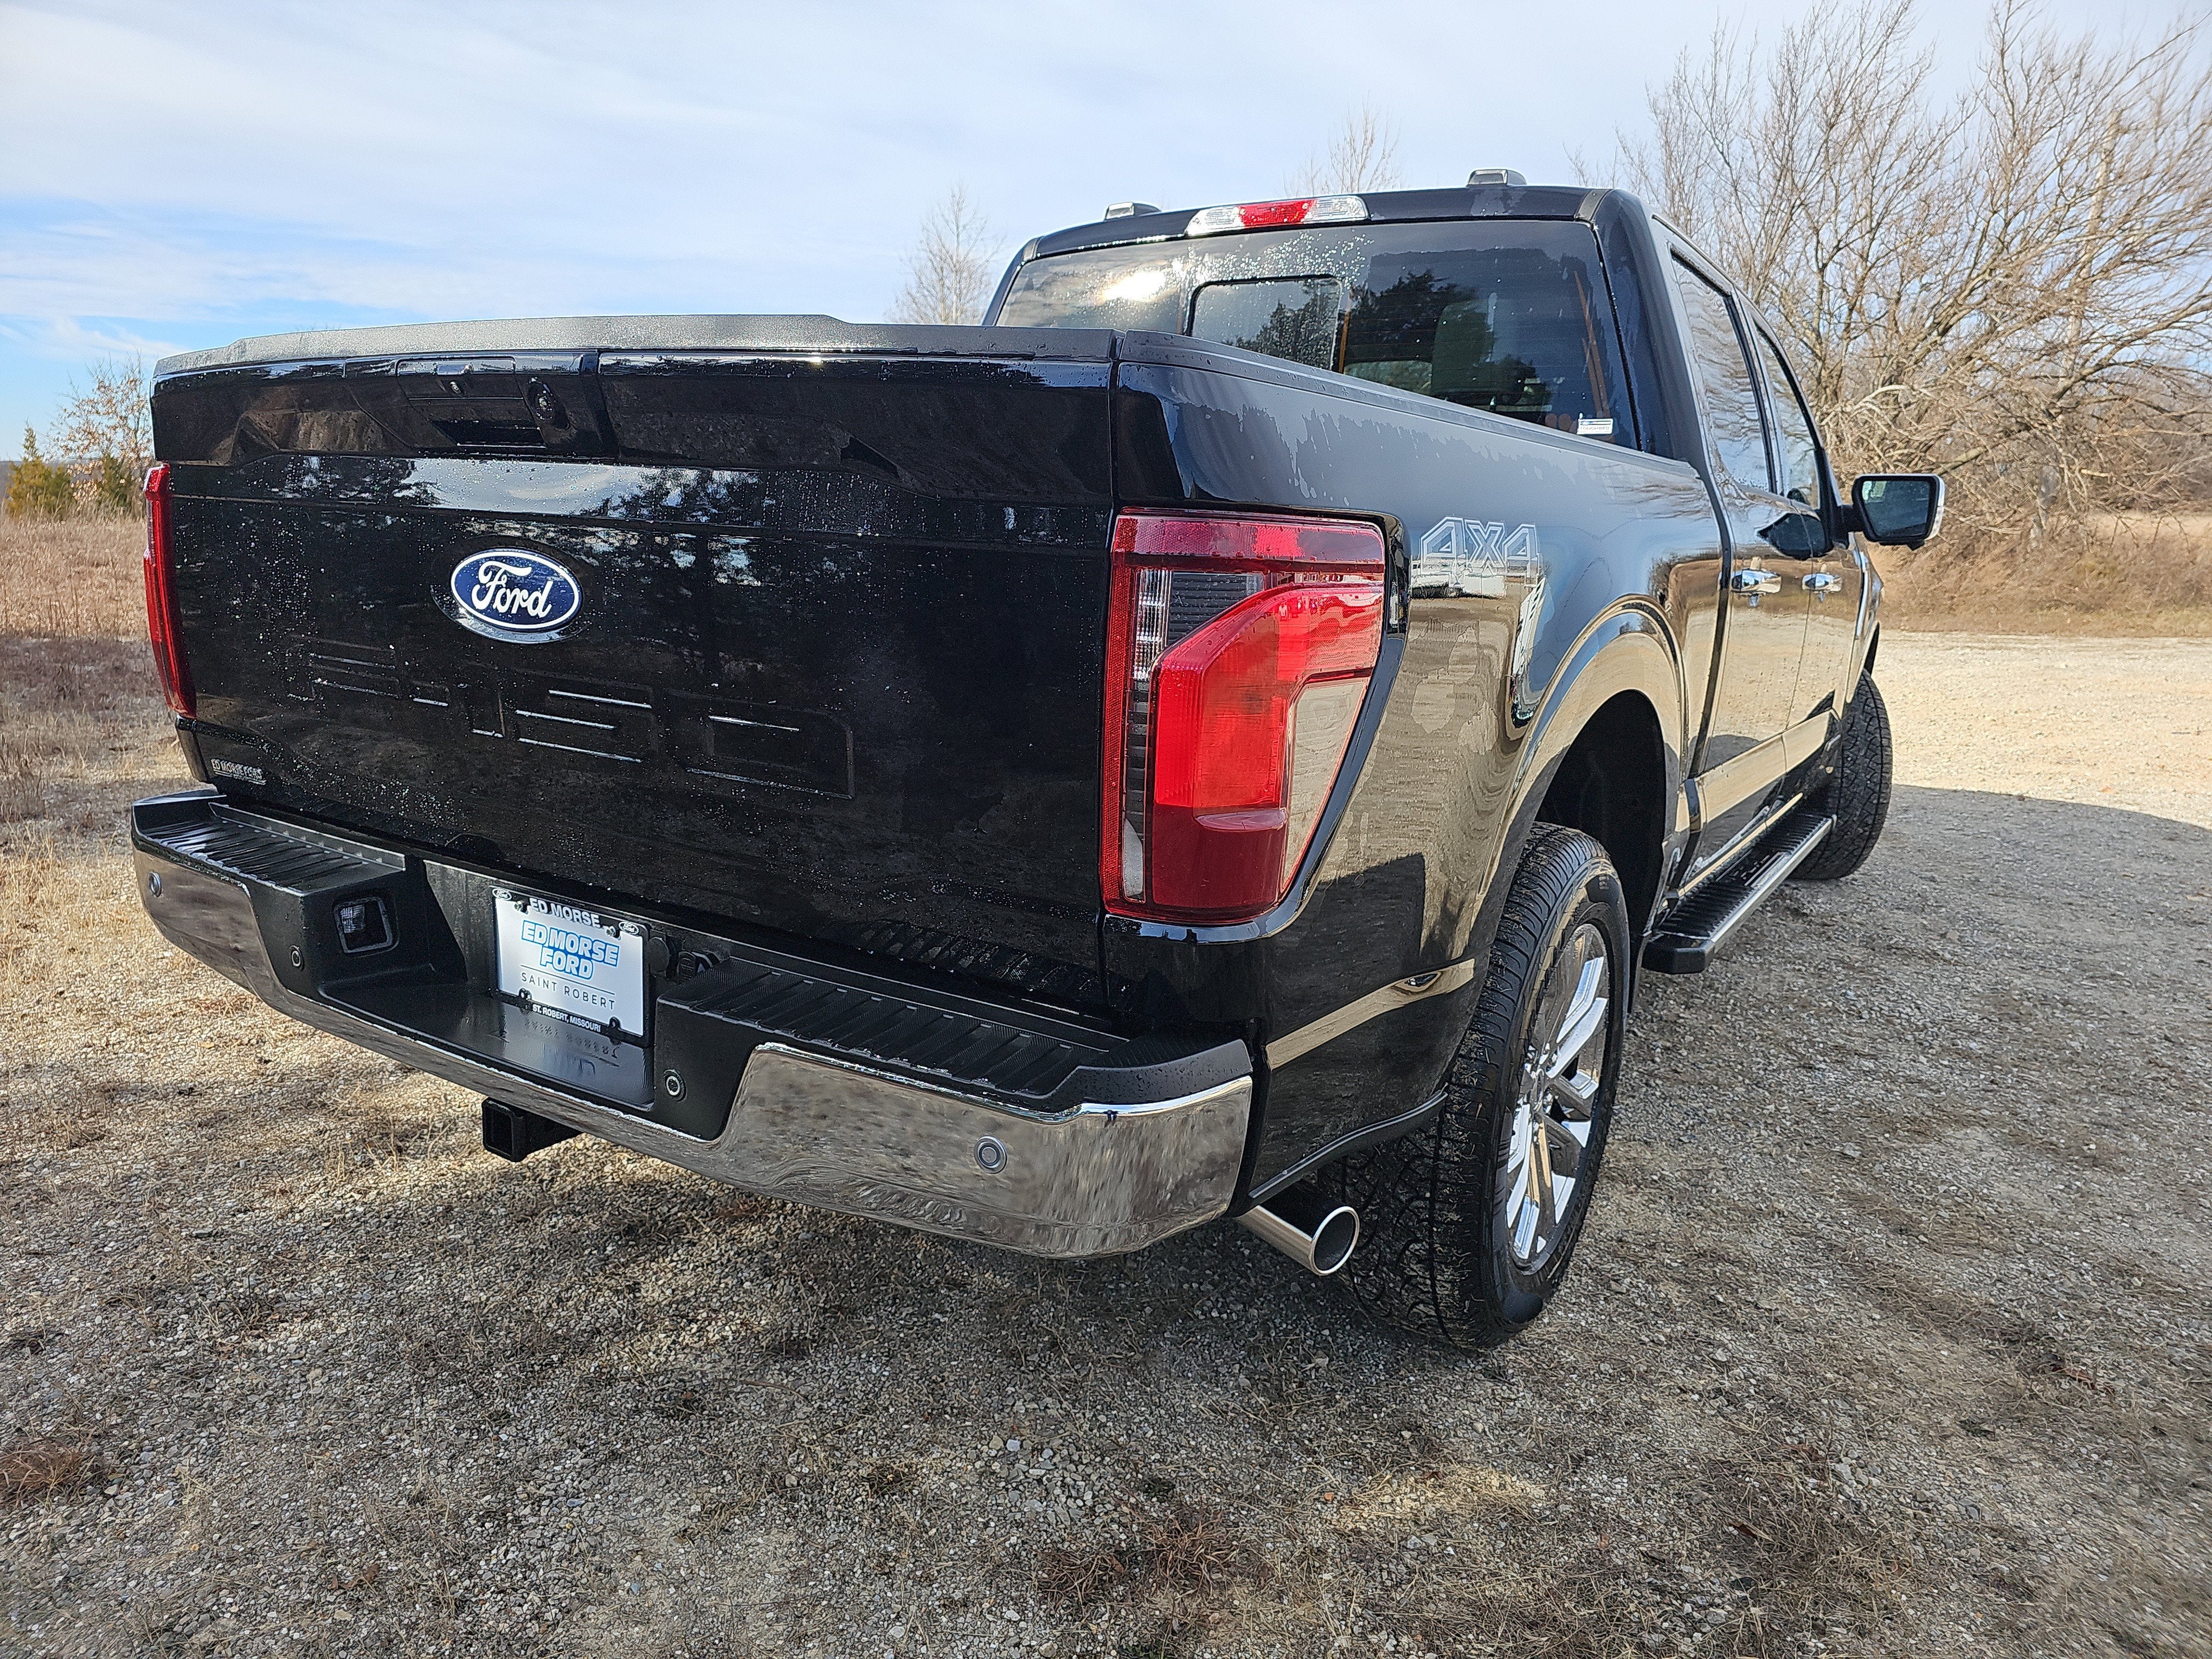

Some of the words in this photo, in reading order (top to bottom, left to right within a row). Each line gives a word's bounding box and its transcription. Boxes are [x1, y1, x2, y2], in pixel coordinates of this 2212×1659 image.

[471, 560, 554, 618] Ford
[530, 897, 548, 914] ED
[550, 904, 601, 929] MORSE
[522, 920, 548, 945] ED
[548, 927, 620, 967] MORSE
[541, 946, 594, 980] FORD
[521, 972, 557, 992] SAINT
[564, 986, 615, 1011] ROBERT
[532, 1004, 542, 1014] ST.
[569, 1016, 602, 1033] MISSOURI
